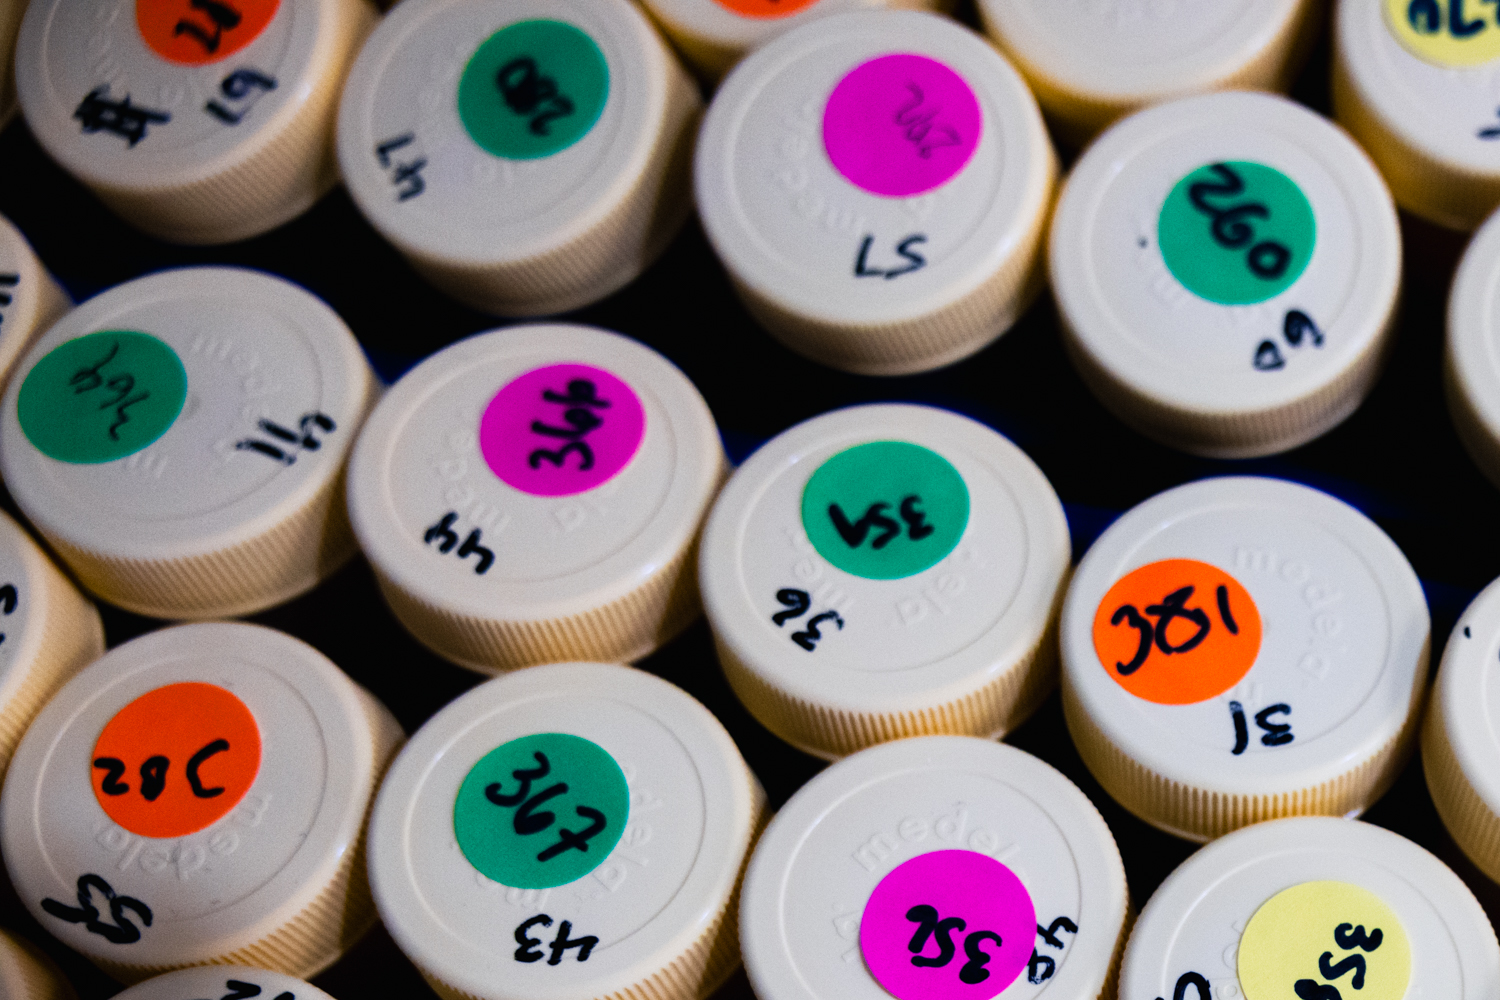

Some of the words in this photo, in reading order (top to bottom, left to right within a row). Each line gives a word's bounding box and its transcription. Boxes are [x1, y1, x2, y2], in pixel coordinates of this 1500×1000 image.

[1188, 163, 1292, 280] 260
[424, 512, 496, 575] 44
[1110, 585, 1240, 676] 381
[1230, 700, 1294, 756] 31
[485, 751, 607, 862] 367
[513, 914, 600, 966] 43
